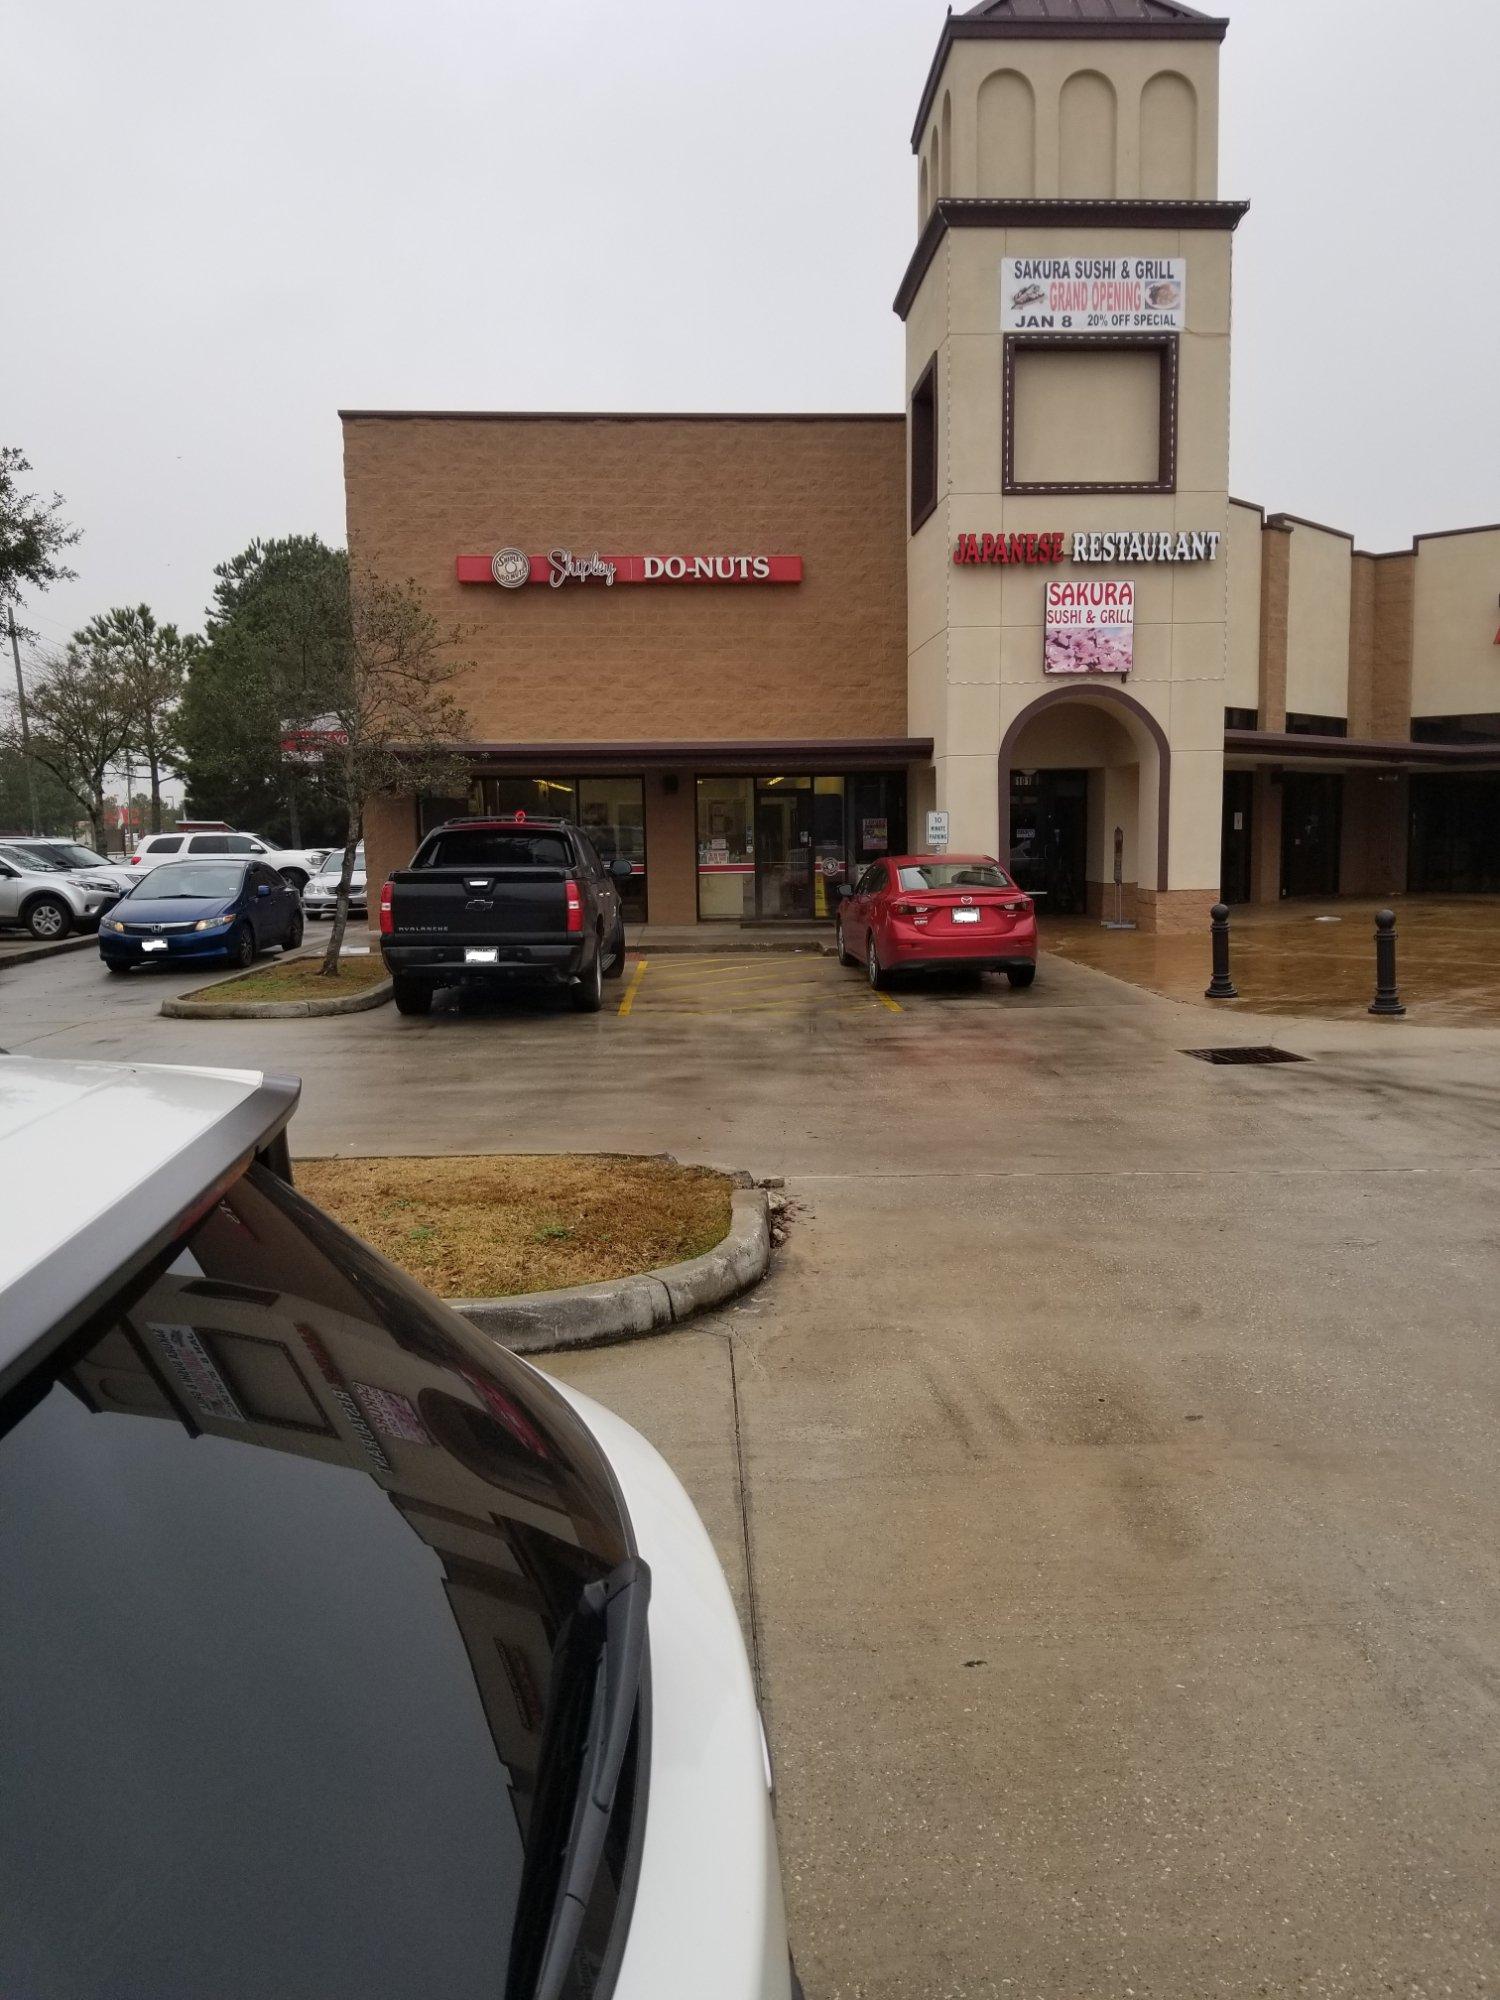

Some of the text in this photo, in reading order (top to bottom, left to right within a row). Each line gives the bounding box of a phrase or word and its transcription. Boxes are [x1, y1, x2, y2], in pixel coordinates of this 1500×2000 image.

[1014, 260, 1174, 279] SAKURA SUSHI & GRILL
[1049, 281, 1141, 311] GRAND OPENING
[1015, 315, 1073, 327] JAN 8
[1087, 314, 1176, 326] 20% OFF SPECIAL
[954, 531, 1221, 564] JAPANESE RESTAURANT
[547, 549, 616, 588] Shipley
[643, 556, 770, 579] DO-NUTS
[1049, 582, 1133, 606] SAKURA
[1047, 609, 1133, 624] SUSHI & GRILL
